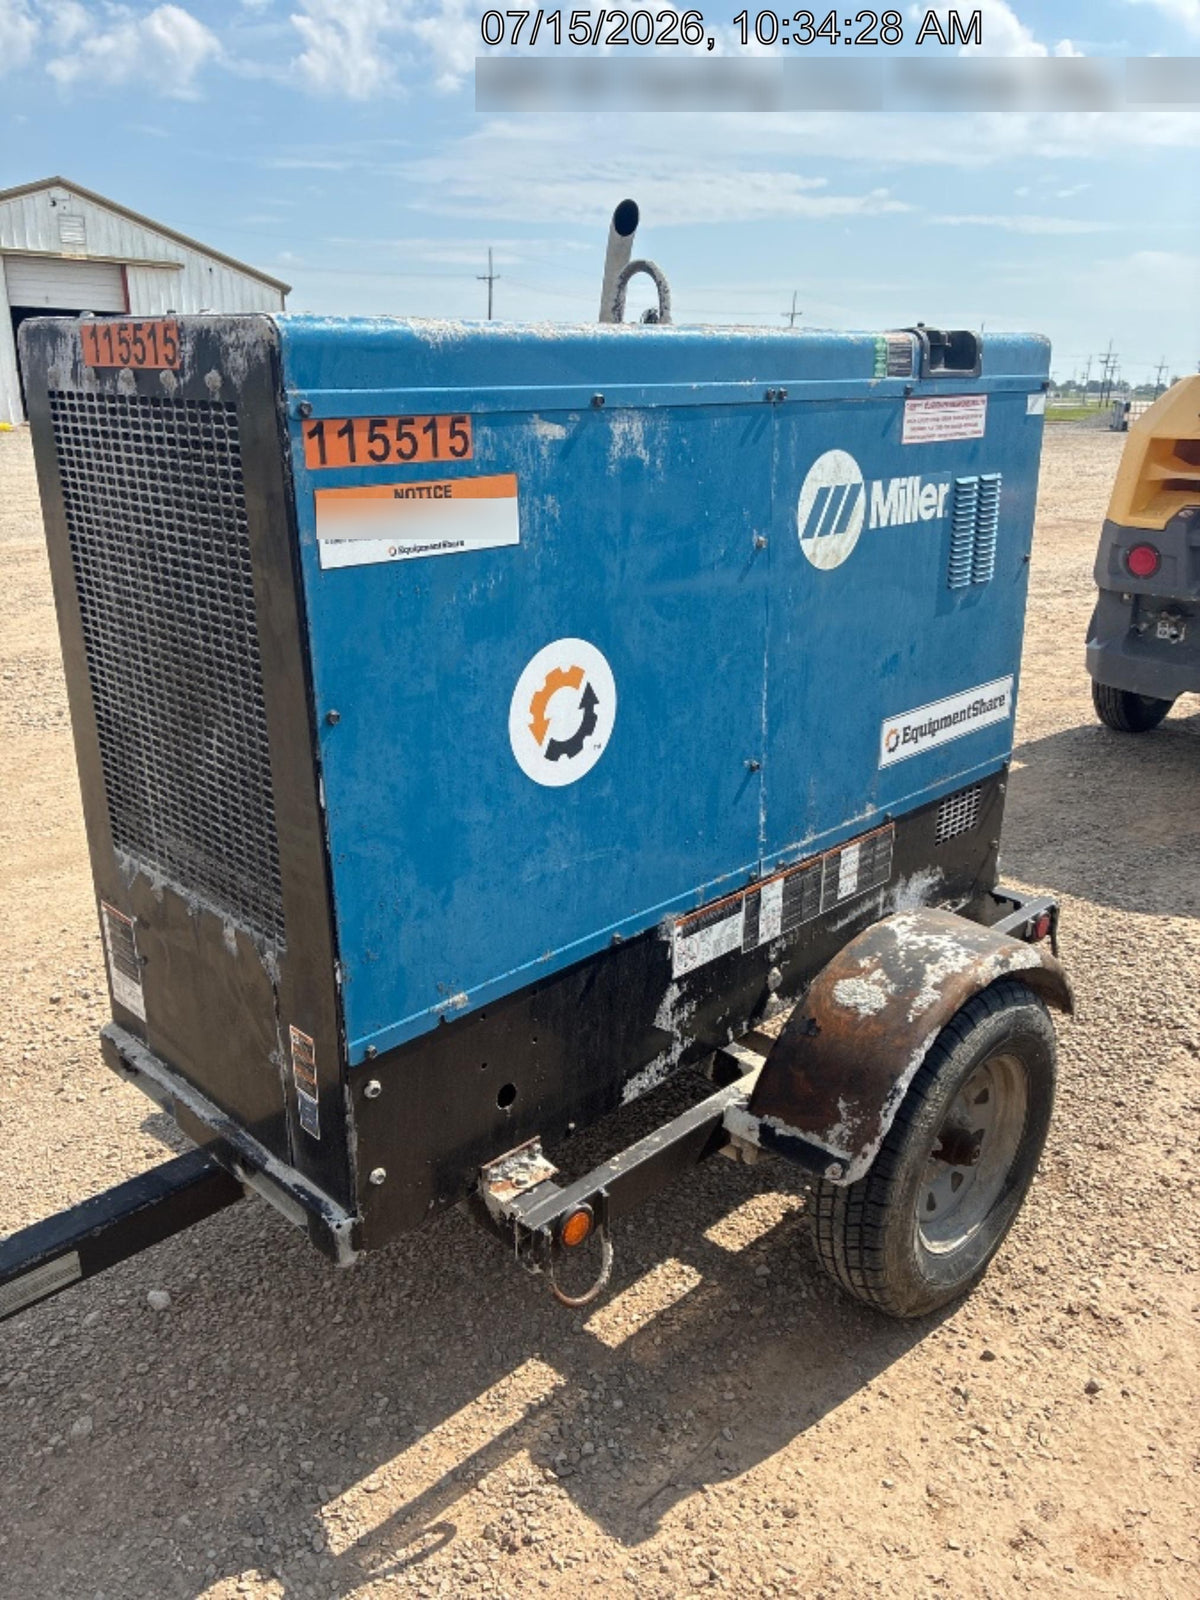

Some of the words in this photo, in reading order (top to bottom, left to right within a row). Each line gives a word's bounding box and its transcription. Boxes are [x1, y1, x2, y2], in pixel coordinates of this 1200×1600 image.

[89, 322, 177, 366] 115515
[307, 415, 470, 465] 115515
[394, 484, 453, 499] NOTICE
[868, 476, 949, 530] Miller
[901, 694, 1006, 746] EquipmentShare
